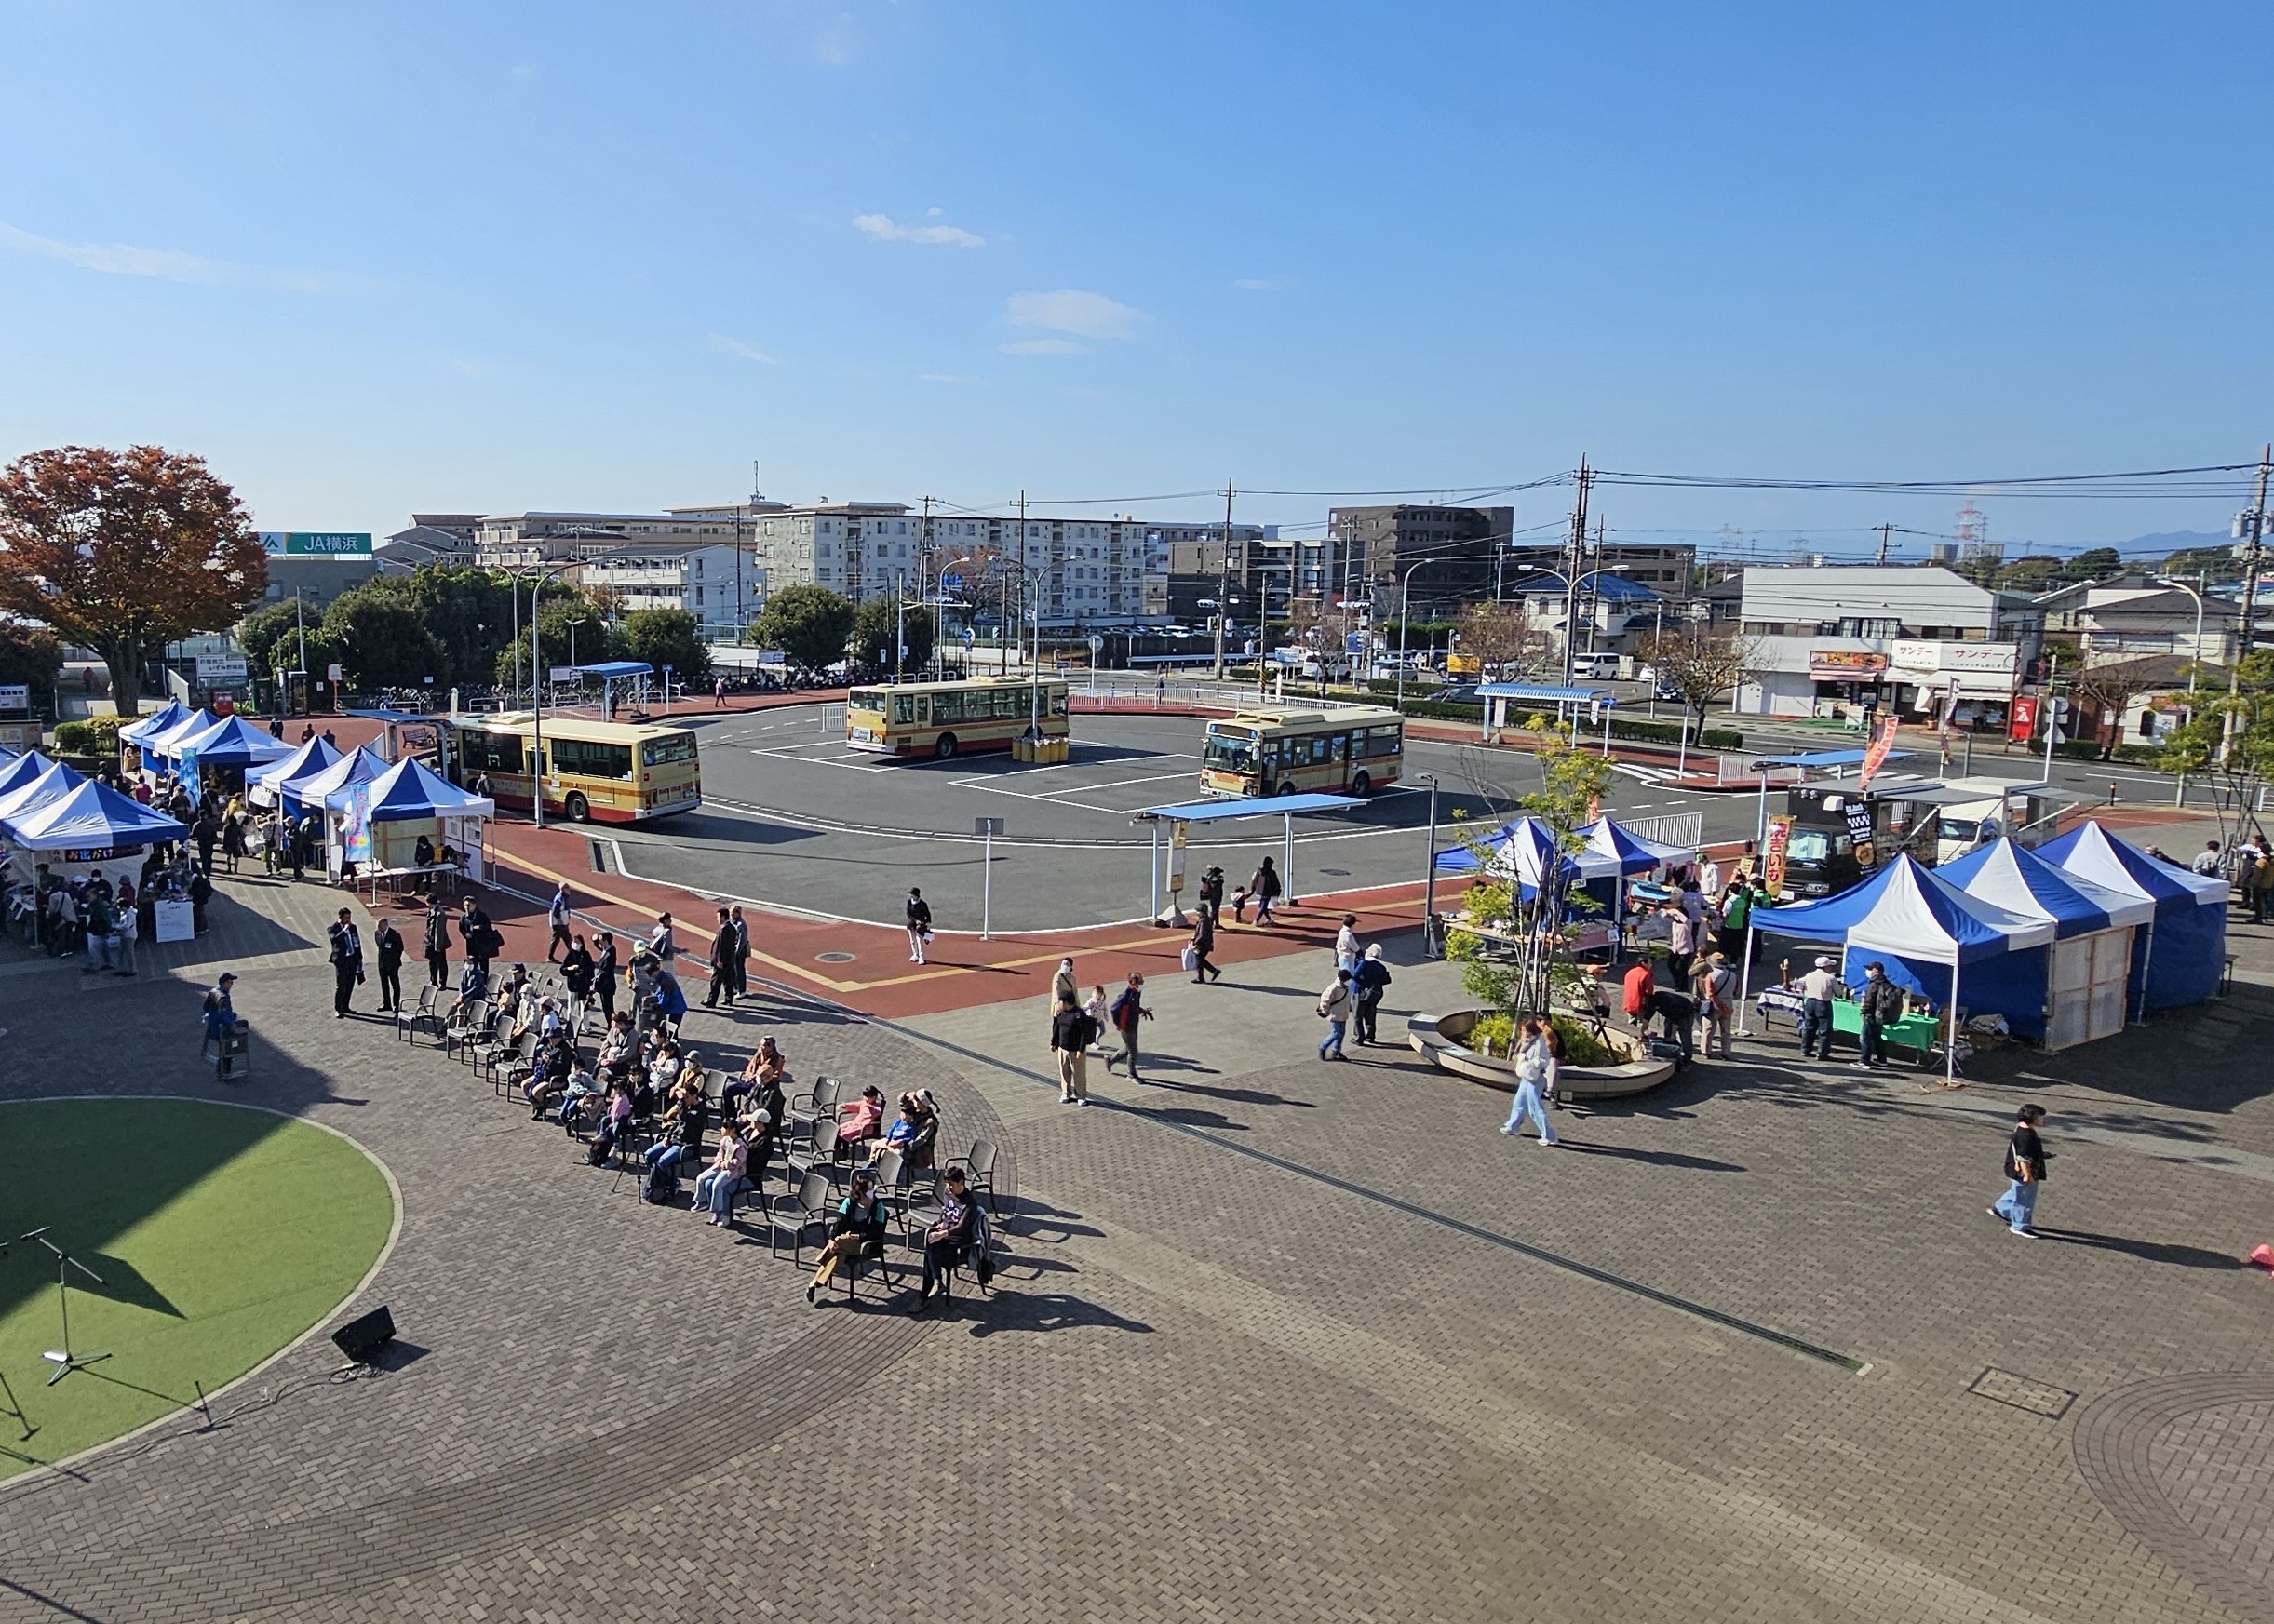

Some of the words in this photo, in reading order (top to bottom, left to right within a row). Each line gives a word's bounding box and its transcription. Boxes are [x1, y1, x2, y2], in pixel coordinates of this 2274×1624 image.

[304, 536, 358, 551] JA横浜
[1900, 647, 1933, 655] サンデー
[1956, 649, 2005, 658] サンデー
[68, 849, 113, 860] お出かけ
[1769, 822, 1788, 882] 焼きいも
